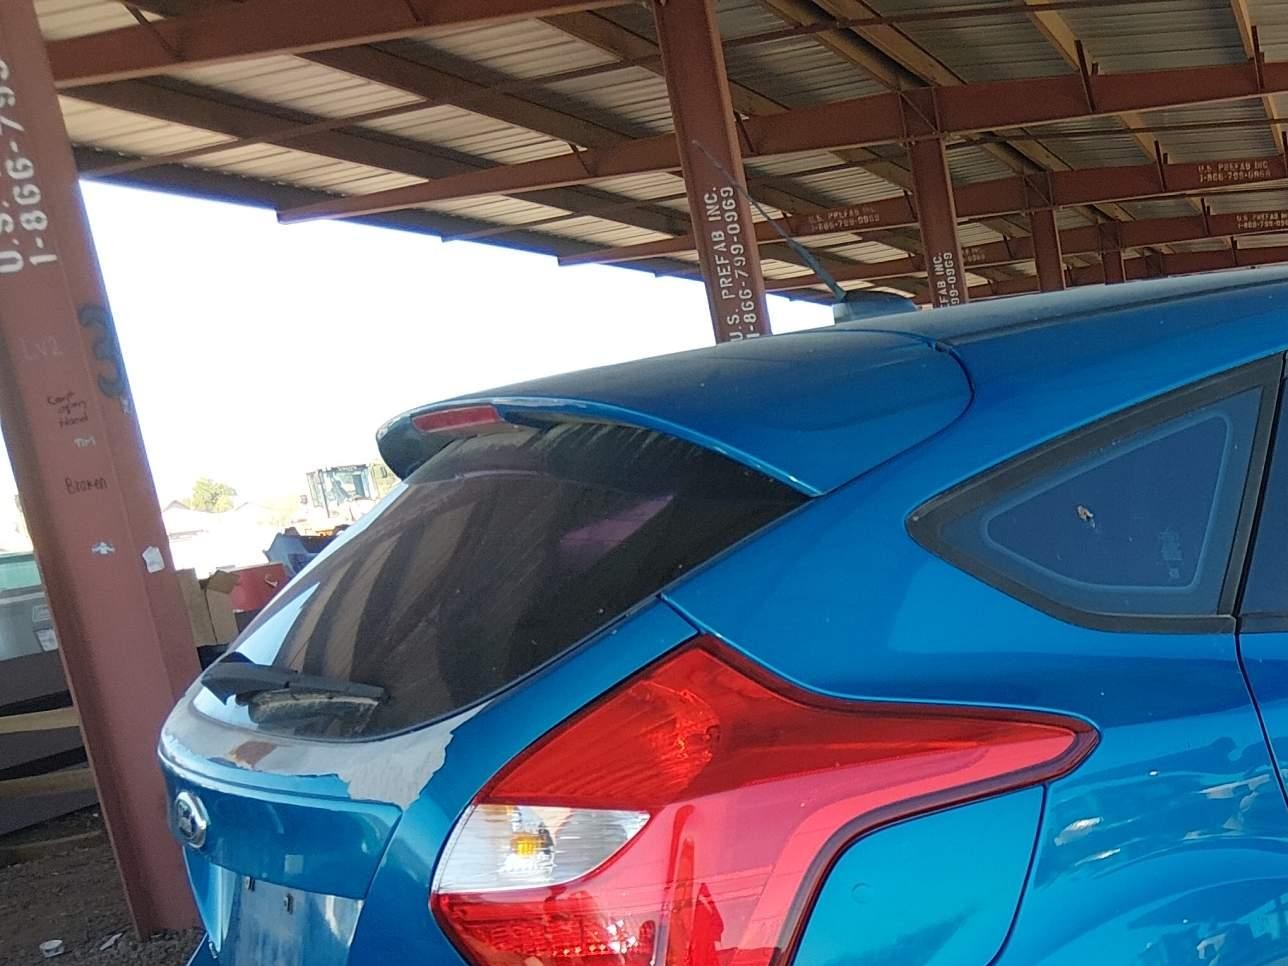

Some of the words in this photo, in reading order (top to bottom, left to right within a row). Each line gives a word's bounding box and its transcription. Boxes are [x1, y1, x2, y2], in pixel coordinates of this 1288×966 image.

[703, 186, 722, 222] INC.
[710, 230, 737, 300] PREFAB
[720, 186, 761, 340] 1-866-799-0969
[932, 252, 945, 276] INC.
